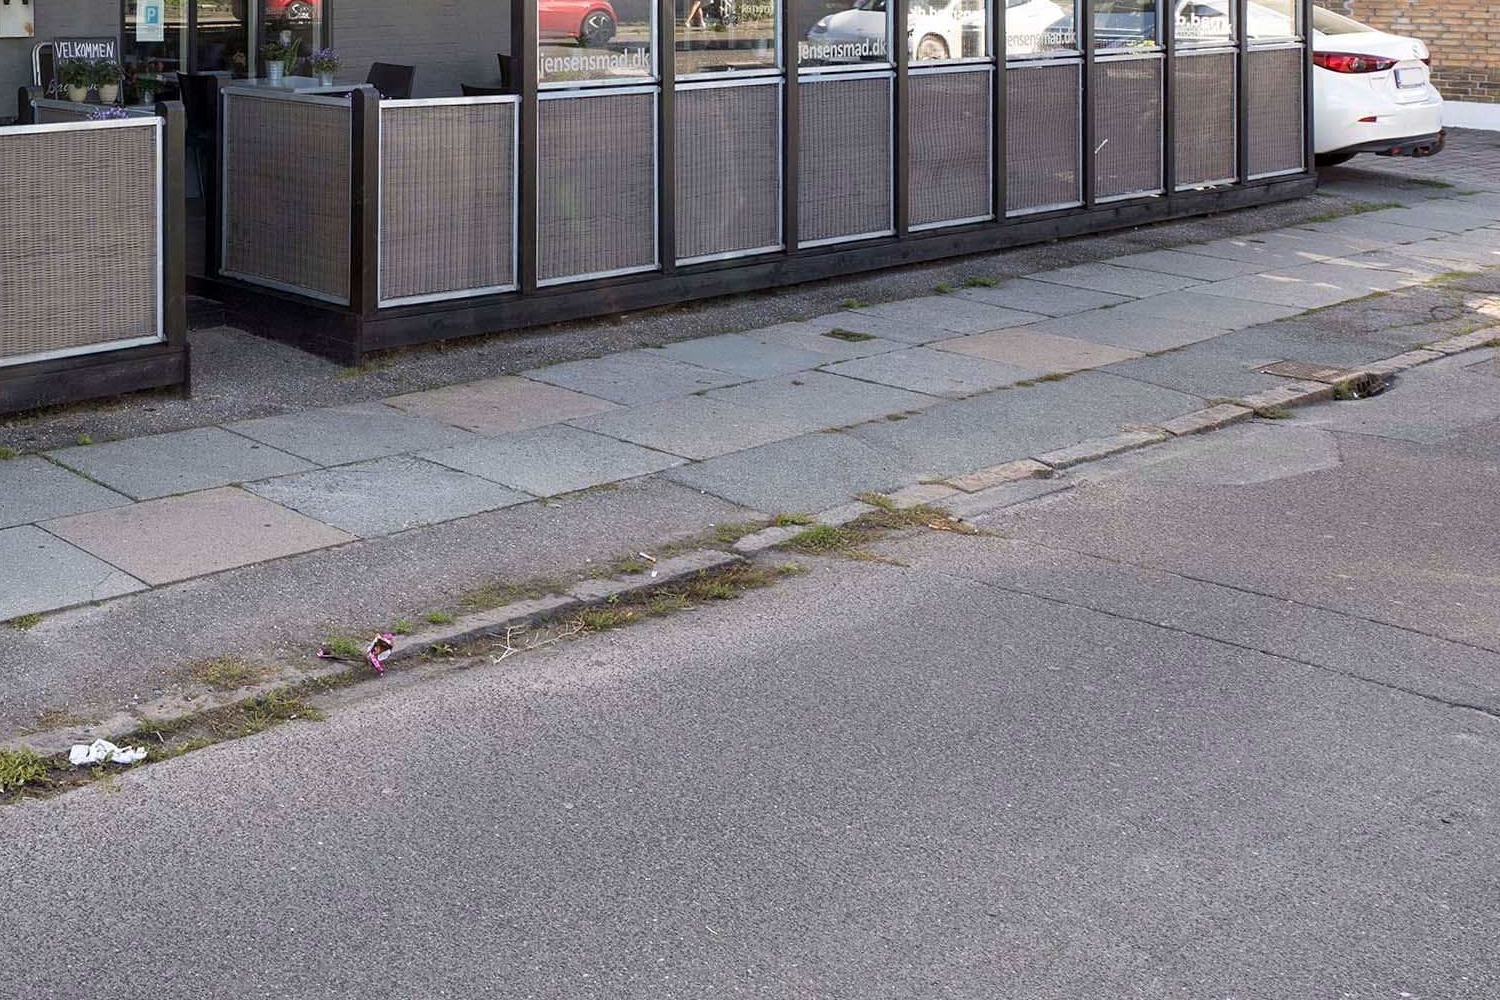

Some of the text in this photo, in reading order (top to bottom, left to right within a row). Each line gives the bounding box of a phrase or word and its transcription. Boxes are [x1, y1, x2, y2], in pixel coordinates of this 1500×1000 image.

[54, 41, 115, 59] VELKOMMEN
[539, 47, 651, 79] jensensmad.dk
[797, 38, 887, 64] jensensmad.dk
